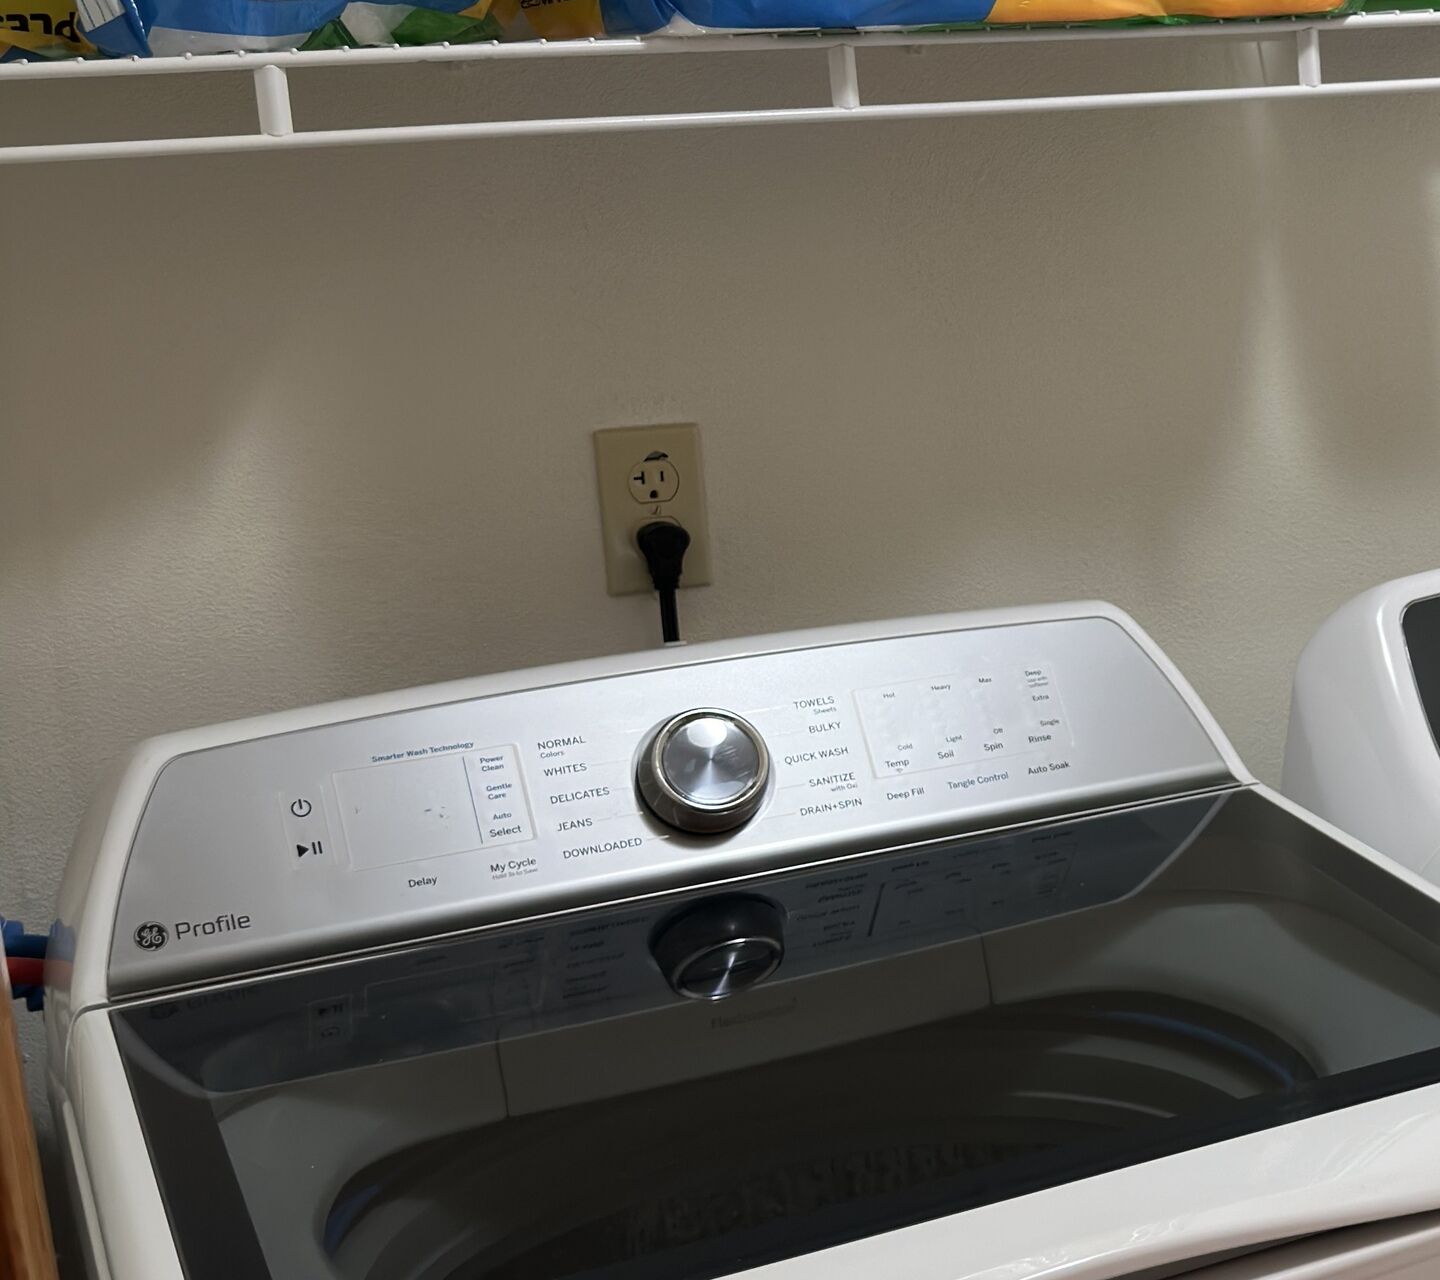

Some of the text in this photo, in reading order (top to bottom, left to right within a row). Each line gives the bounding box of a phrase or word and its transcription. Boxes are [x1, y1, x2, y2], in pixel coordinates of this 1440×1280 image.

[793, 696, 836, 710] TOWELS
[1032, 694, 1050, 702] Extra
[808, 721, 842, 734] BULKY
[537, 735, 587, 751] NORMAL
[946, 734, 963, 744] Light
[1028, 733, 1052, 744] Rinse
[371, 741, 475, 764] Smarter Wash Technology
[983, 741, 1004, 753] Spin
[479, 755, 504, 764] Power
[540, 750, 565, 760] Colors
[784, 746, 849, 766] QUICK WASH
[937, 750, 955, 760] Soil
[481, 763, 505, 772] Clean
[543, 762, 588, 777] WHITES
[885, 758, 910, 769] Temp
[1027, 760, 1071, 776] Auto Soak
[809, 771, 856, 788] SANITIZE
[947, 771, 1010, 790] Tangle Control
[486, 782, 512, 792] Gentle
[488, 792, 507, 801] Care
[550, 786, 611, 805] DELICATES
[886, 787, 925, 802] Deep Fill
[800, 797, 863, 817] DRAIN+SPIN
[492, 812, 513, 821] Auto
[557, 817, 594, 832] JEANS
[489, 825, 523, 839] Select
[562, 837, 643, 860] DOWNLOADED
[490, 857, 538, 874] My Cycle
[408, 876, 439, 889] Delay
[175, 914, 252, 940] Profile
